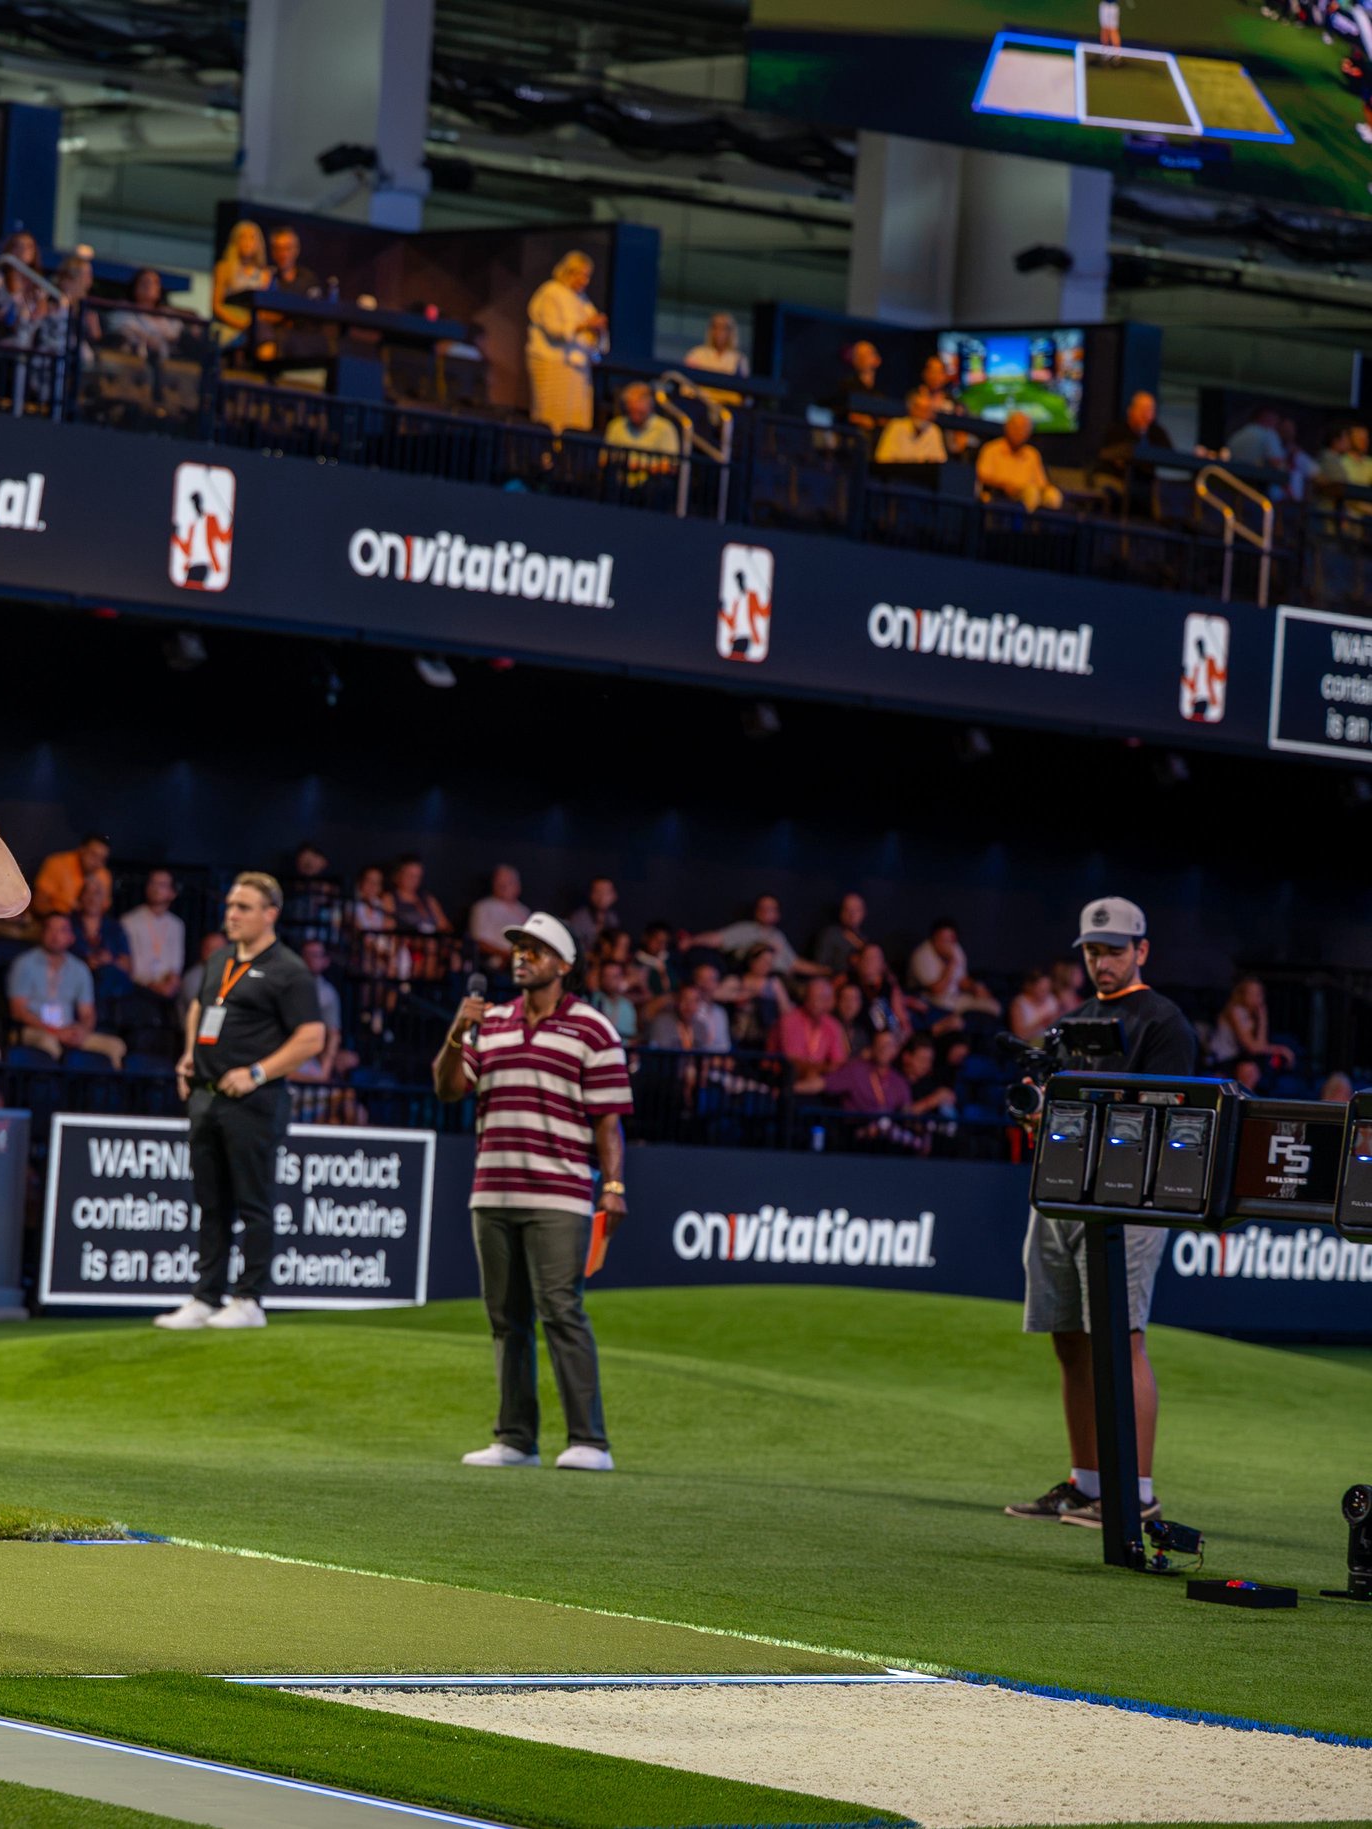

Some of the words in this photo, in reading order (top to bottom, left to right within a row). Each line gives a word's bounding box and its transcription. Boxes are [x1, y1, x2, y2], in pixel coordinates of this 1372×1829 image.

[89, 1137, 194, 1181] WARNI
[303, 1148, 401, 1194] product
[1268, 1135, 1312, 1174] FS
[72, 1192, 189, 1232] contains
[304, 1197, 407, 1239] Nicotine
[80, 1242, 107, 1281] is
[109, 1250, 150, 1282] an
[271, 1247, 391, 1288] chemical.
